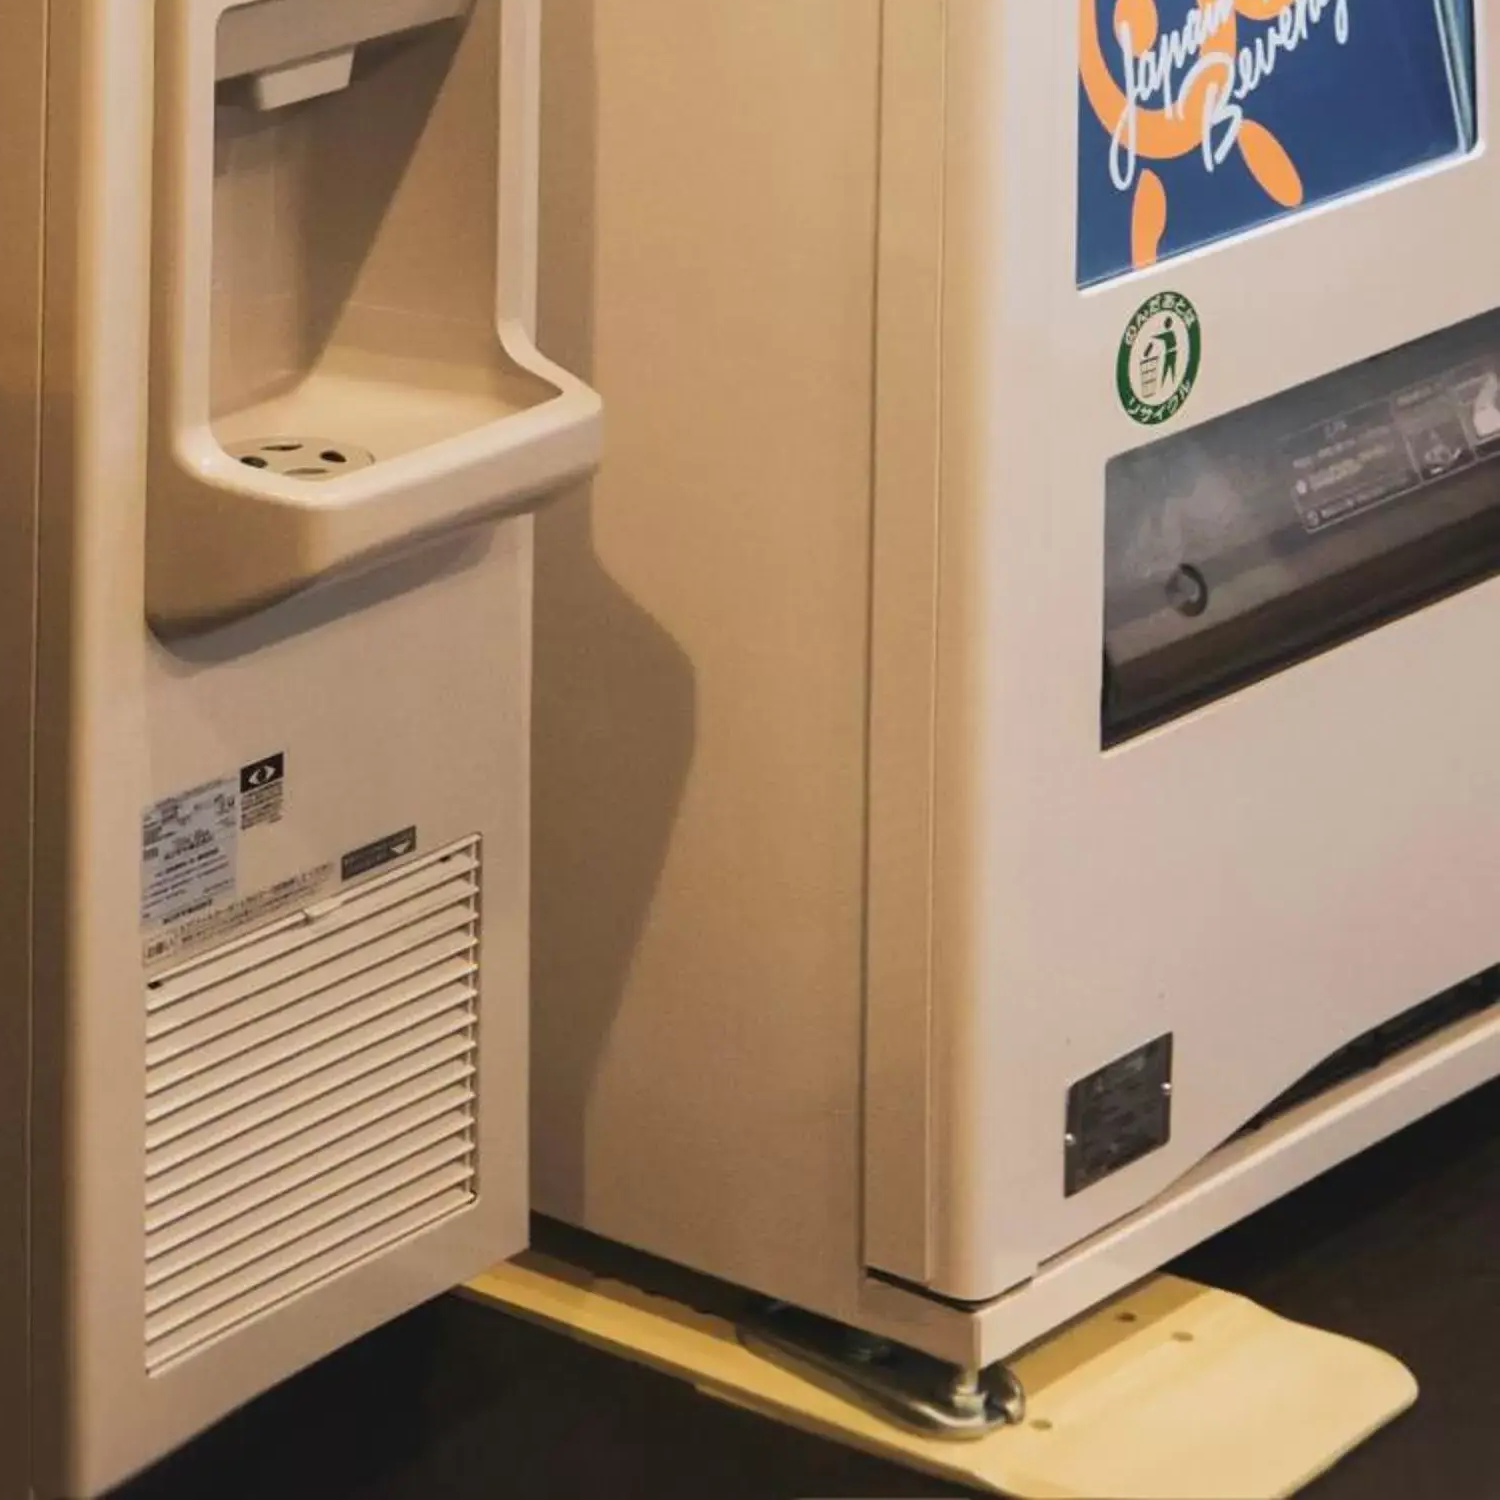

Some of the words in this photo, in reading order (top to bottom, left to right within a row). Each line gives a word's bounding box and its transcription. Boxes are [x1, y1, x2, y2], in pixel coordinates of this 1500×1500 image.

[1126, 380, 1192, 422] リサイクル
